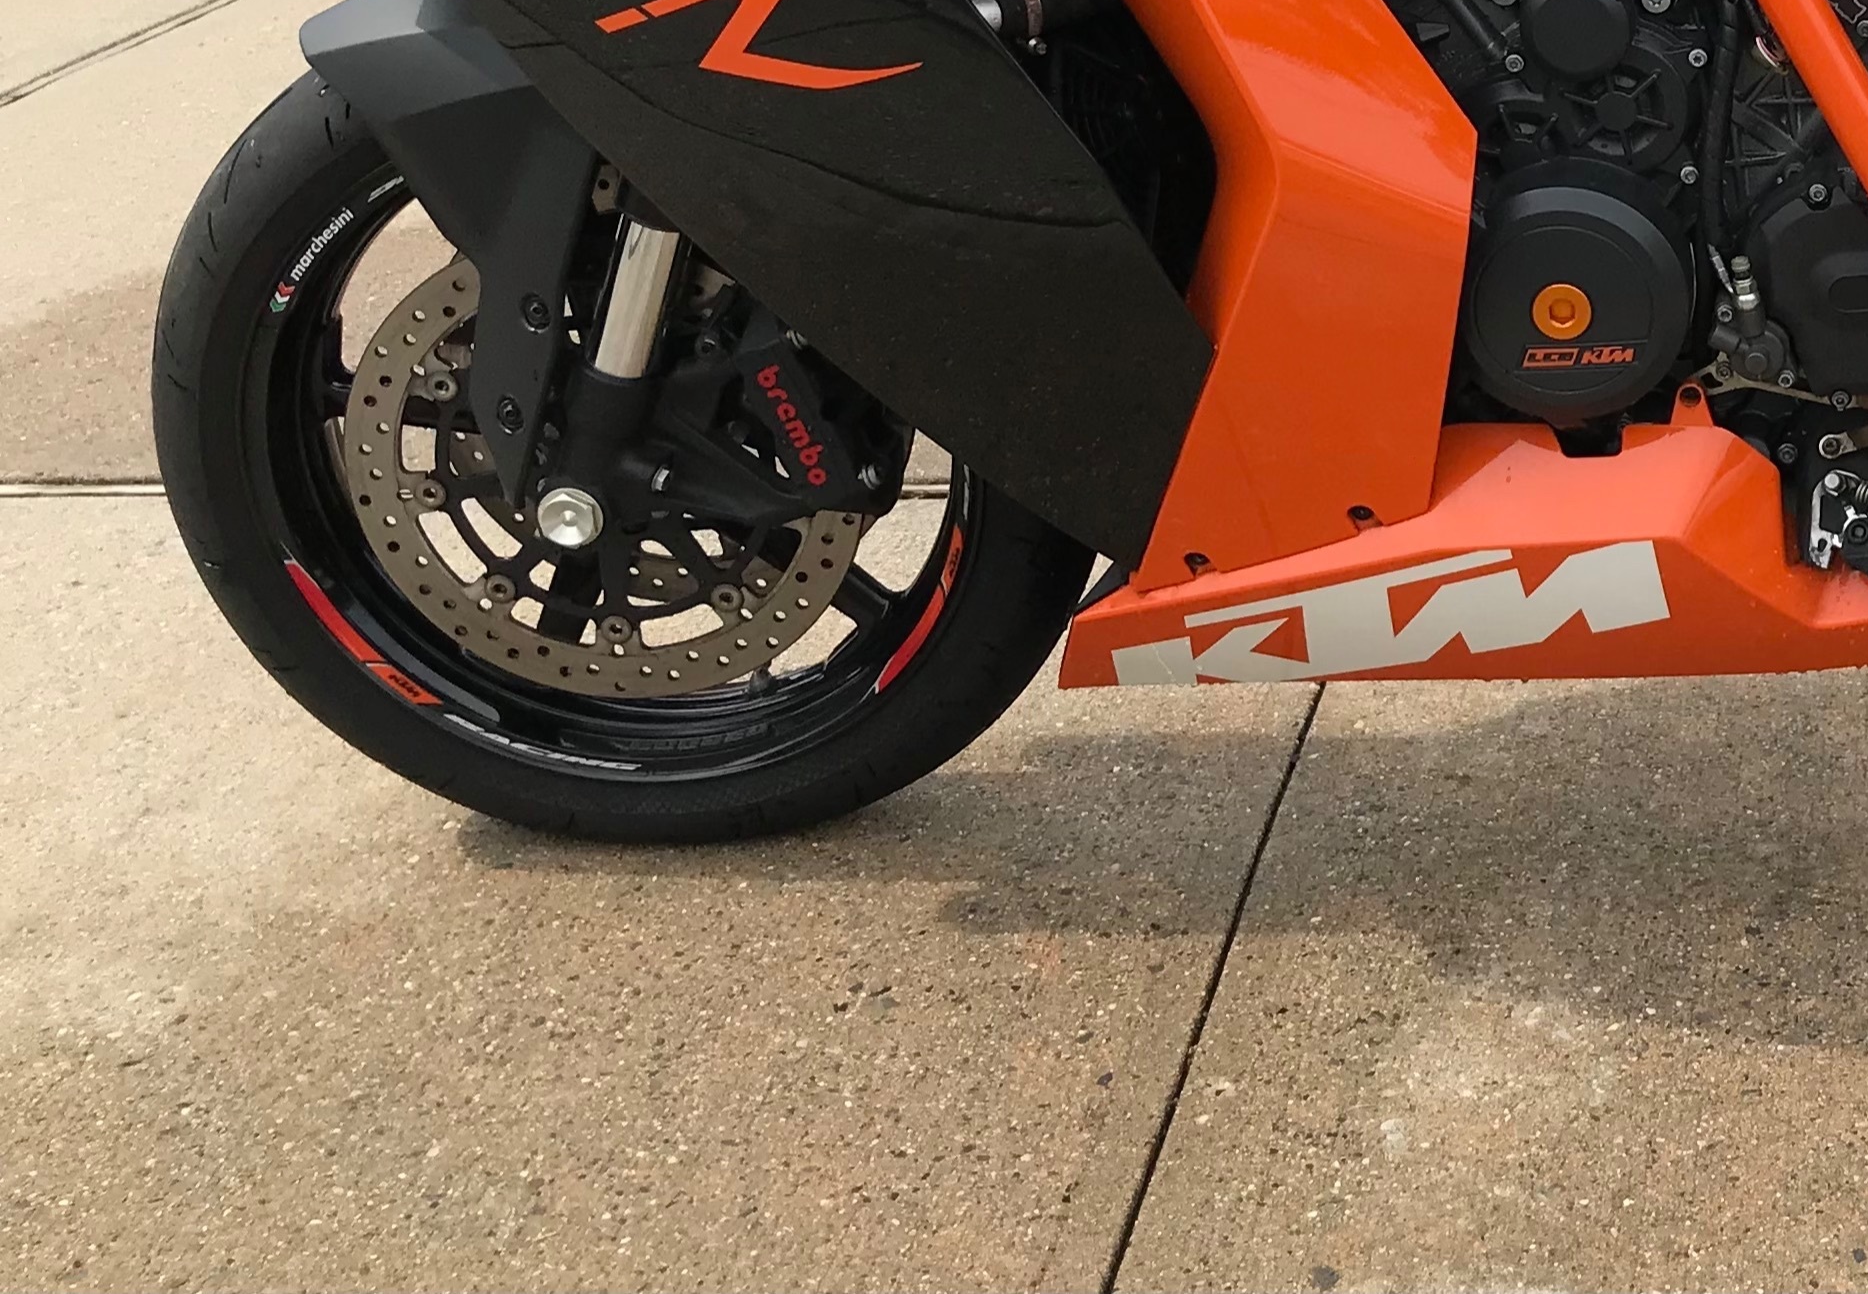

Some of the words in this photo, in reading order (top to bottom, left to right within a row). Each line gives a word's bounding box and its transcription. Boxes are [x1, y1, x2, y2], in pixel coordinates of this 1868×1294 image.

[290, 207, 354, 281] marchesini
[1581, 347, 1634, 364] KTM
[757, 364, 827, 485] brembo
[1111, 540, 1671, 685] KTM
